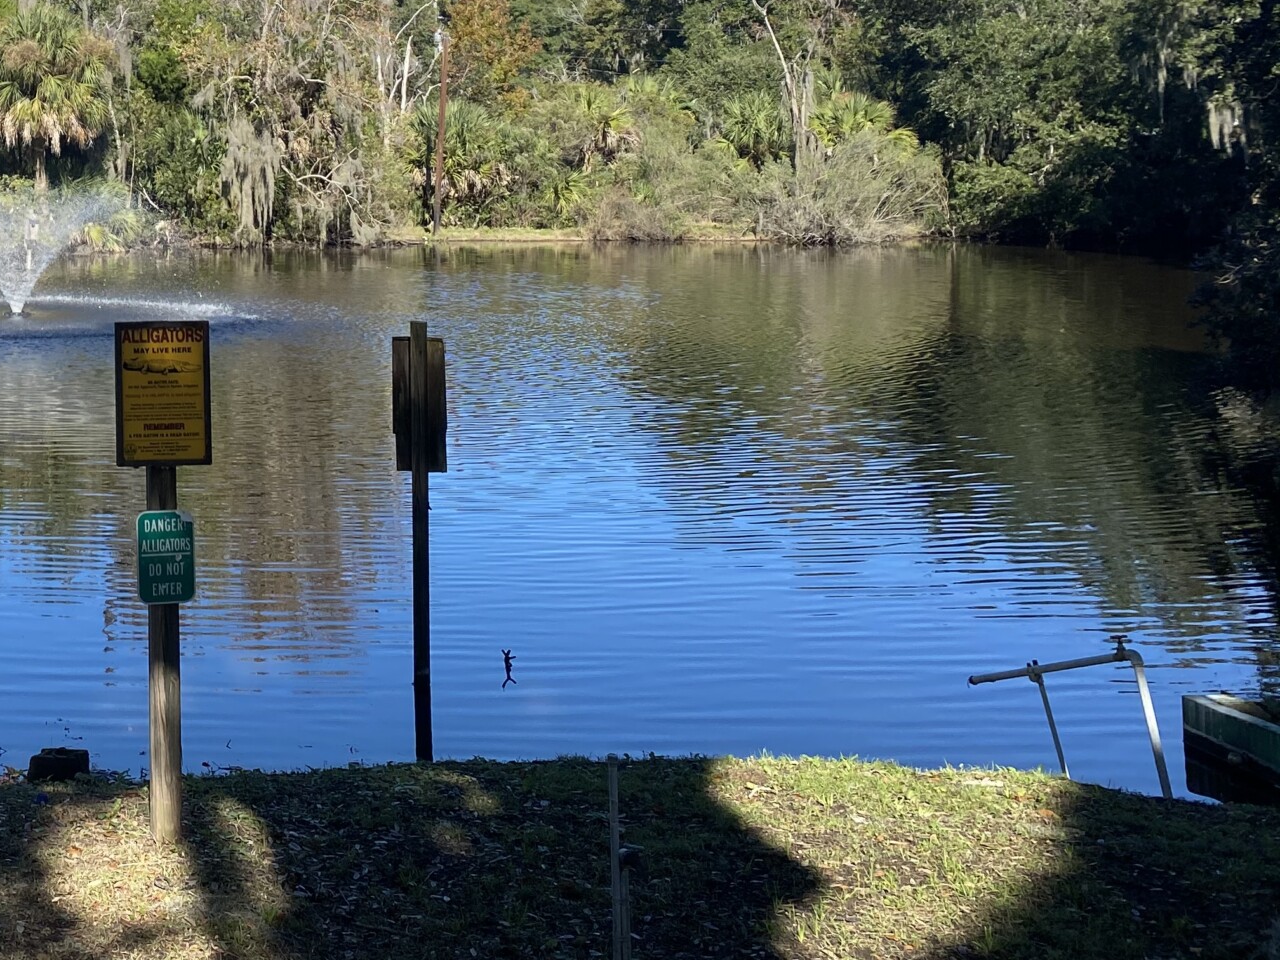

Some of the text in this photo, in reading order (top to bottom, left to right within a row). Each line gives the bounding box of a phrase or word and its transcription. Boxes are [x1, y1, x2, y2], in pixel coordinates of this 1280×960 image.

[122, 327, 203, 343] ALLIGATORS
[144, 423, 184, 431] REMEMBER
[142, 538, 191, 552] ALLIGATORS
[149, 562, 185, 576] DO NOT
[152, 582, 182, 596] ENTER
